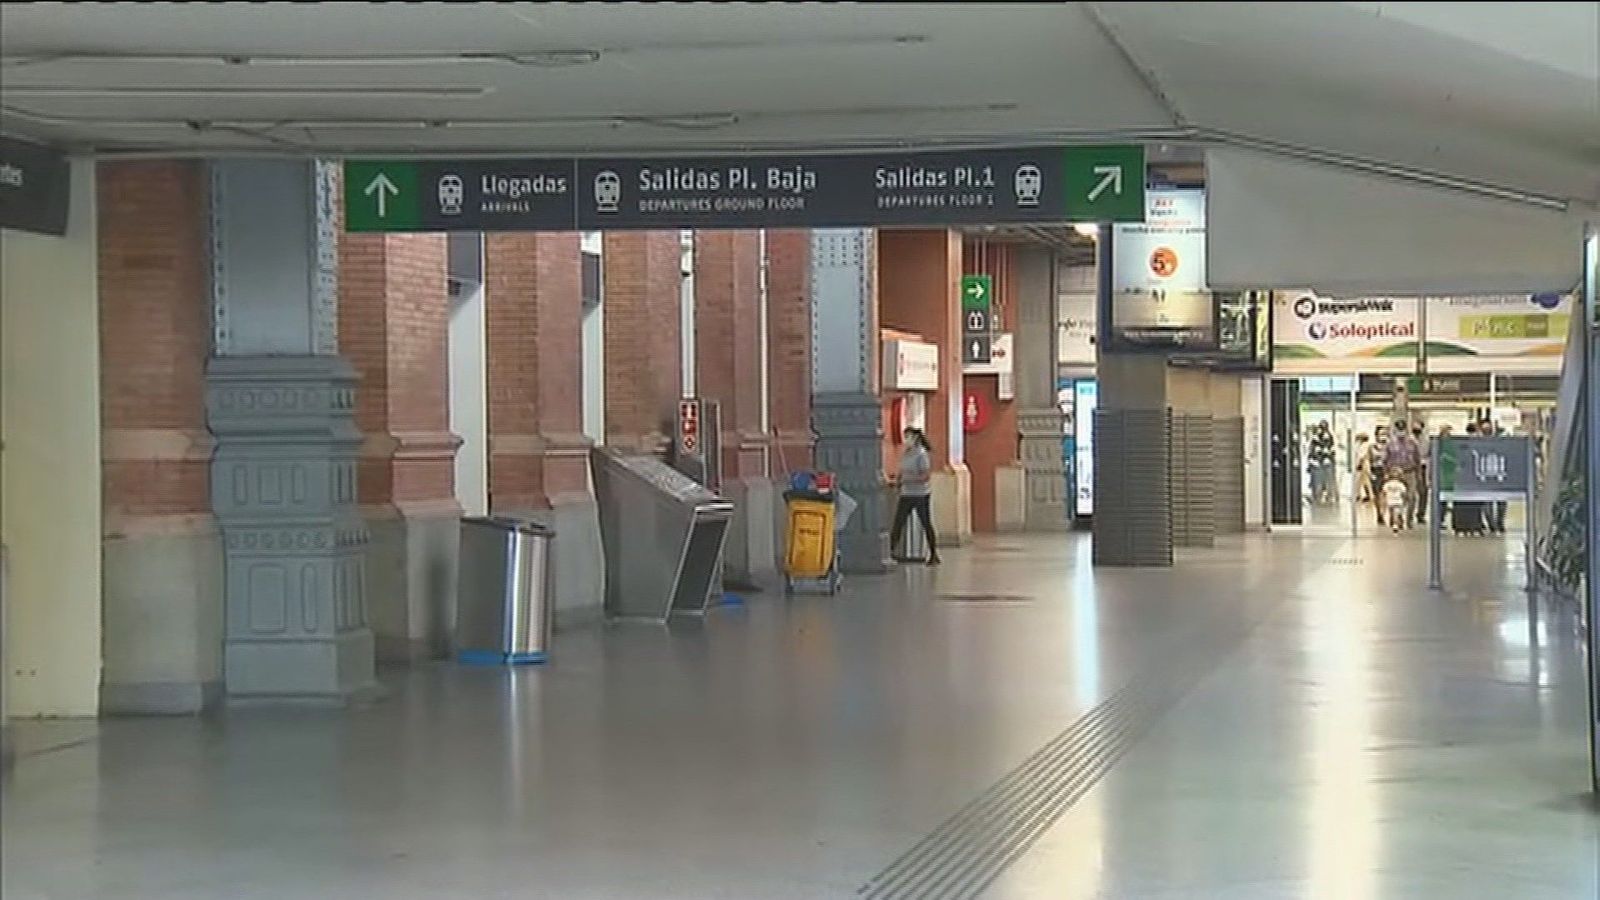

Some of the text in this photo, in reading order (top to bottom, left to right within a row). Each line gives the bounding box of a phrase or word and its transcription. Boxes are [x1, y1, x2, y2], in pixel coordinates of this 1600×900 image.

[481, 174, 567, 199] Llegadas
[639, 165, 817, 194] Salidas Pl. Baja
[875, 165, 995, 189] Salidas Pl.1
[639, 197, 805, 212] DEPARTURES GROUND FLOOR
[877, 195, 946, 208] DEPARTURES
[949, 194, 983, 206] FLOOR
[1328, 322, 1415, 339] Soloptical
